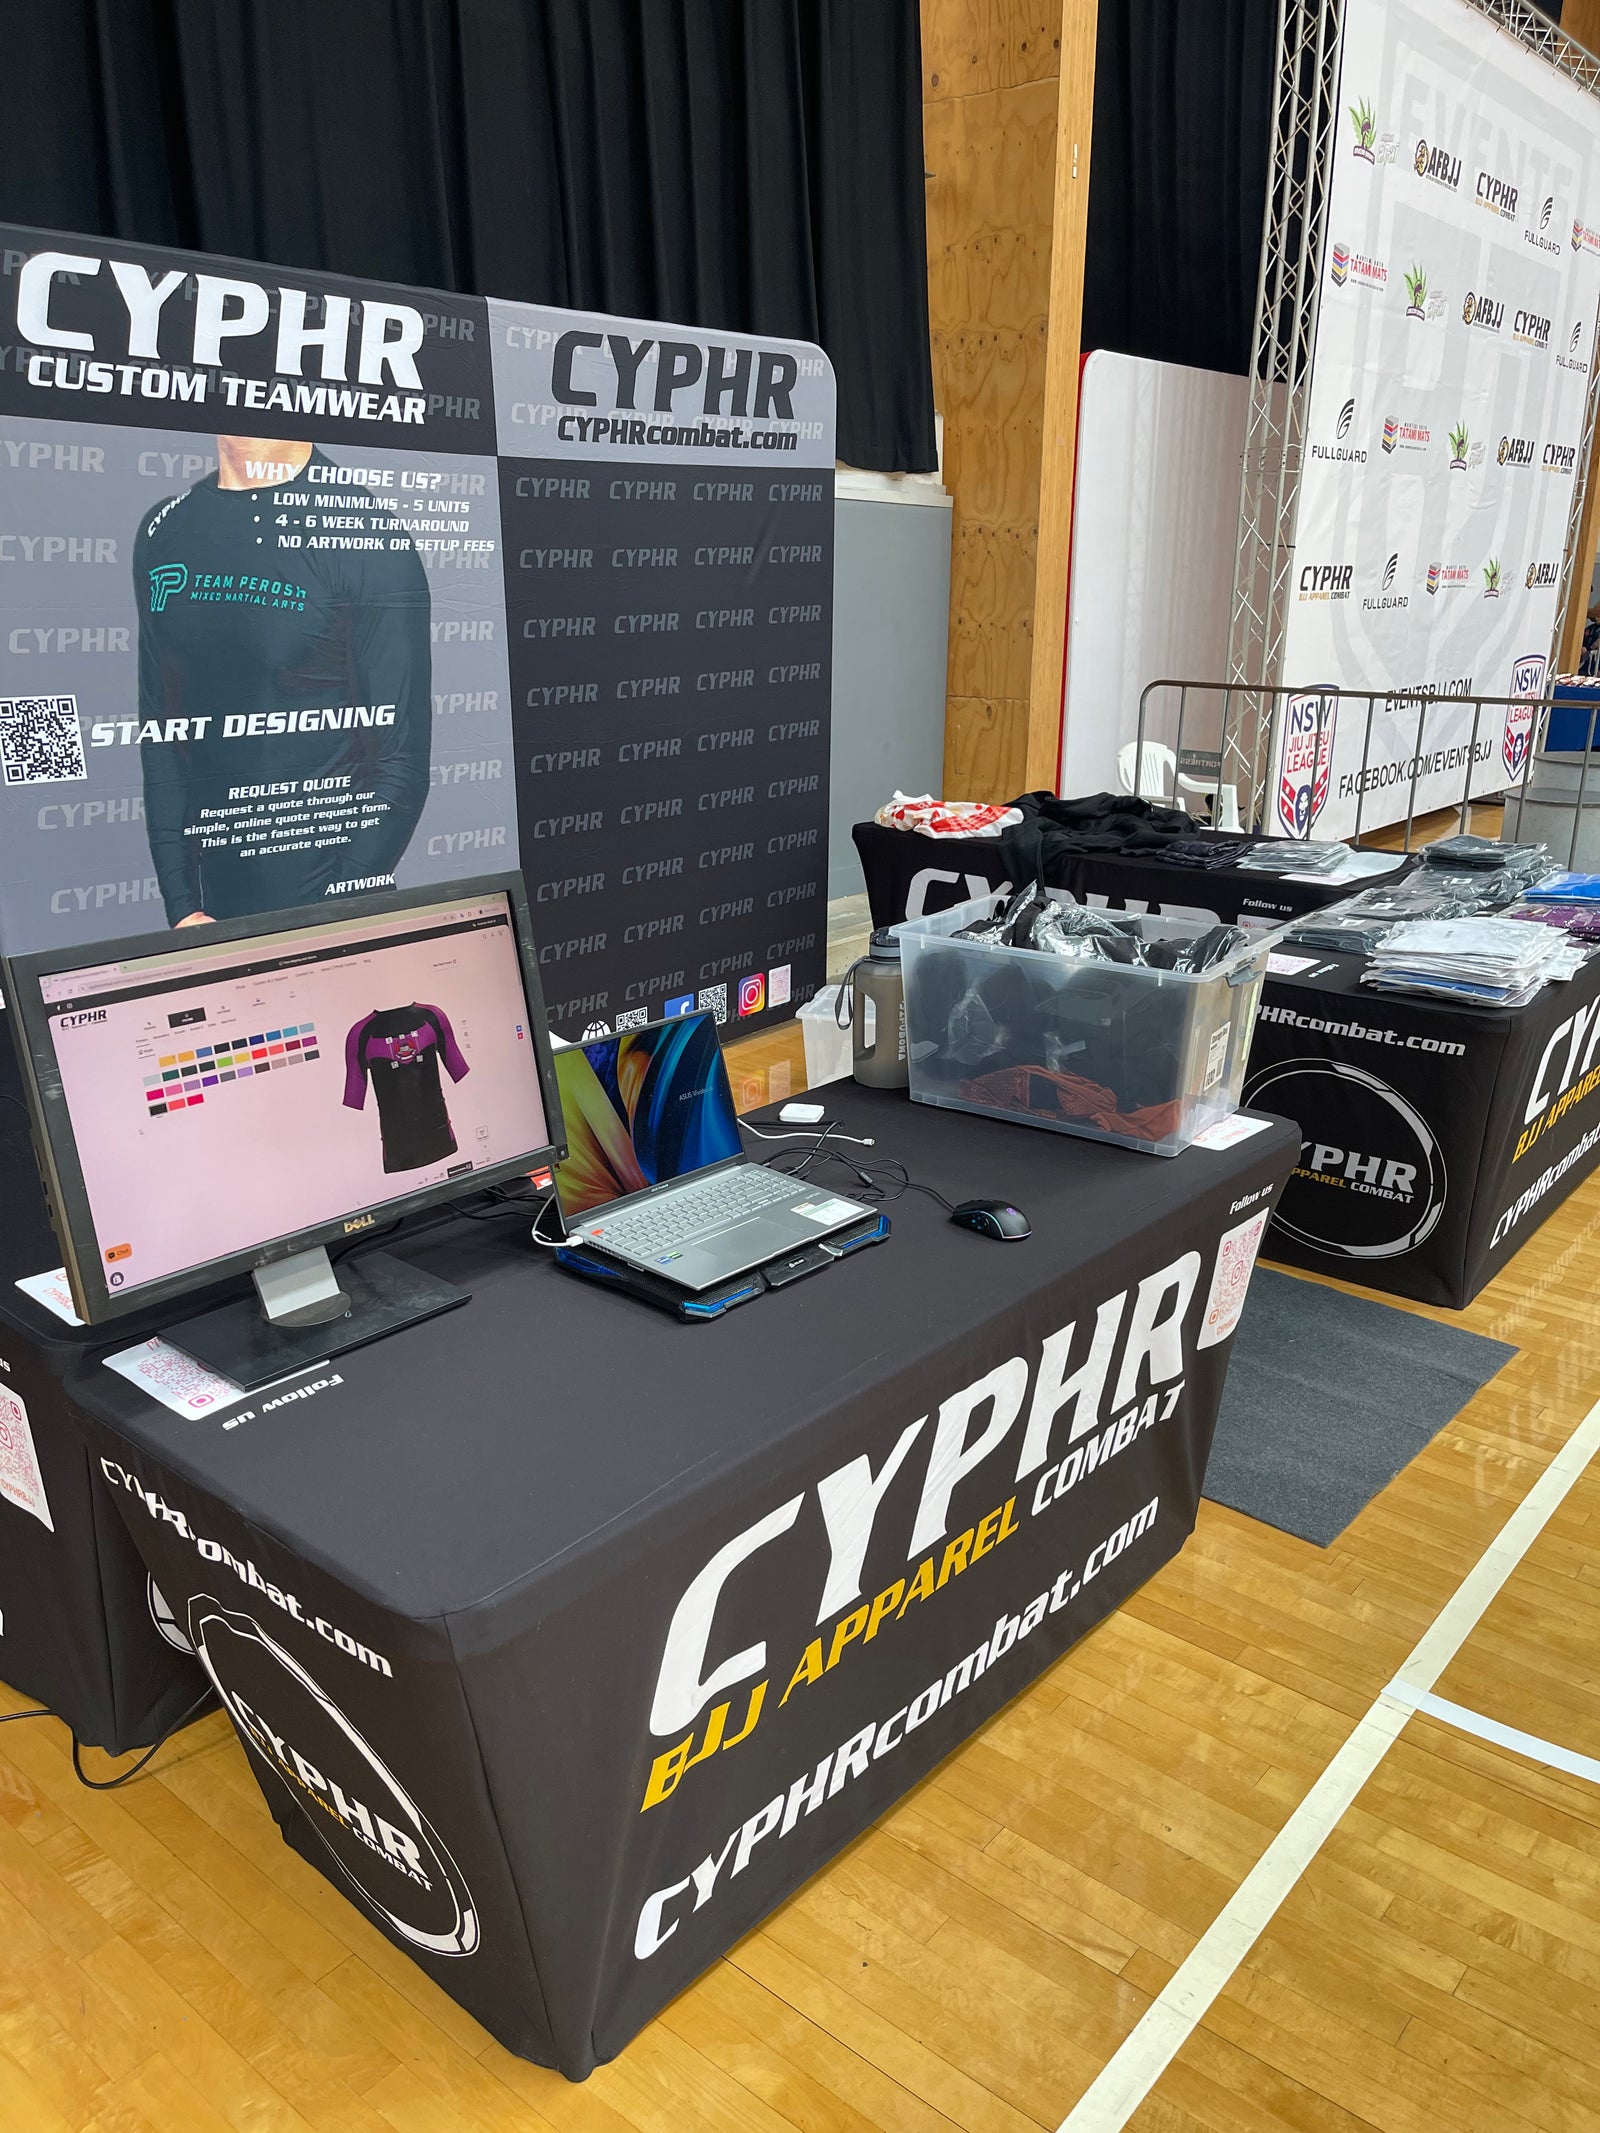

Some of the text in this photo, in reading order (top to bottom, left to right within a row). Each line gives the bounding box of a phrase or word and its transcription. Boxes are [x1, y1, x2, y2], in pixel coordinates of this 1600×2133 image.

[1427, 146, 1462, 188] AFBJJ
[1476, 172, 1518, 213] CYPHR
[1524, 230, 1560, 256] FULLGUARD
[17, 251, 424, 390] CYPHR
[1475, 296, 1505, 329] AFBJJ
[1514, 310, 1551, 342] CYPHR
[552, 330, 797, 420] CYPHR
[28, 355, 426, 425] CUSTOM TEAMWEAR
[558, 415, 797, 451] CYPHRcombat.com
[0, 440, 105, 473] YPHR
[1312, 445, 1367, 463] FULLGUARD
[1508, 438, 1535, 464] AFBJJ
[1543, 443, 1576, 468] CYPHR
[245, 460, 442, 490] WHY CHOOSE US?
[515, 477, 591, 499] CYPHR
[273, 492, 470, 514] LOW MINIMUMS 5 UNITS
[609, 481, 676, 501] CYPHR
[693, 482, 753, 502] CYPHR
[768, 484, 823, 502] CYPHR
[275, 513, 470, 533] 4 6 WEEK TURNAROUND
[277, 535, 495, 552] NO ARTWORK OR SETUP FEES
[694, 546, 753, 566] CYPHR
[768, 545, 822, 564] CYPHR
[519, 548, 593, 569] CYPHR
[612, 547, 677, 568] CYPHR
[194, 574, 234, 589] TEAM
[1300, 565, 1353, 591] CYPHR
[1535, 563, 1559, 585] AFBJJ
[190, 591, 305, 612] MIXED MARTIAL ARTS
[1331, 591, 1350, 600] COMBAT
[1363, 597, 1409, 610] FULLGUARD
[523, 616, 596, 639] CYPHR
[614, 612, 679, 634] CYPHR
[695, 608, 754, 630] CYPHR
[768, 604, 821, 625] CYPHR
[8, 627, 131, 655] CYPHR
[430, 620, 494, 643] YPHR
[697, 669, 754, 691] CYPHR
[768, 662, 821, 684] CYPHR
[1514, 667, 1541, 694] NSW
[526, 683, 599, 707] CYPHR
[616, 676, 680, 700] CYPHR
[431, 691, 498, 715] YPHR
[91, 716, 212, 748] START
[222, 704, 396, 738] DESIGNING
[1291, 698, 1333, 735] NSW
[697, 728, 754, 752] CYPHR
[768, 719, 820, 742] CYPHR
[618, 737, 682, 763] CYPHR
[1289, 735, 1303, 753] JIU
[530, 748, 600, 774] CYPHR
[228, 776, 351, 800] REQUEST QUOTE
[697, 786, 754, 811] CYPHR
[767, 775, 819, 799] CYPHR
[200, 805, 253, 819] Request
[268, 800, 304, 813] quote
[307, 793, 353, 807] through
[356, 790, 375, 800] our
[620, 798, 683, 824] CYPHR
[183, 802, 391, 836] simple, online quote request form.
[534, 811, 603, 839] CYPHR
[201, 816, 380, 849] This is the fastest way to get
[427, 826, 506, 856] CYPHR
[767, 828, 817, 854] CYPHR
[240, 836, 352, 858] an accurate quote.
[699, 842, 754, 869] CYPHR
[622, 856, 684, 885] CYPHR
[324, 873, 395, 896] ARTWORK
[537, 872, 605, 902] CYPHR
[767, 882, 817, 908] CYPHR
[699, 897, 754, 925] CYPHR
[1242, 898, 1277, 910] Follow
[623, 914, 684, 944] CYPHR
[540, 933, 607, 965] CYPHR
[766, 933, 816, 960] CYPHR
[699, 951, 753, 979] CYPHR
[625, 970, 685, 1001] CYPHR
[60, 1009, 107, 1028] CYPHR
[1511, 1115, 1544, 1165] BJJ
[1301, 1141, 1417, 1194] PHR
[1229, 1183, 1274, 1215] Follow us
[1351, 1181, 1415, 1204] COMBAT
[343, 1214, 375, 1234] DELL
[222, 1374, 344, 1431] Follow us
[649, 1248, 1202, 1736] CYPHR
[640, 1379, 1187, 1814] BJJ APPAREL COMBAT
[633, 1496, 1160, 1961] CYPHRcombat.com
[231, 1691, 429, 1879] CYPHR
[278, 1758, 350, 1830] APPAREL
[352, 1827, 432, 1892] COMBAT
